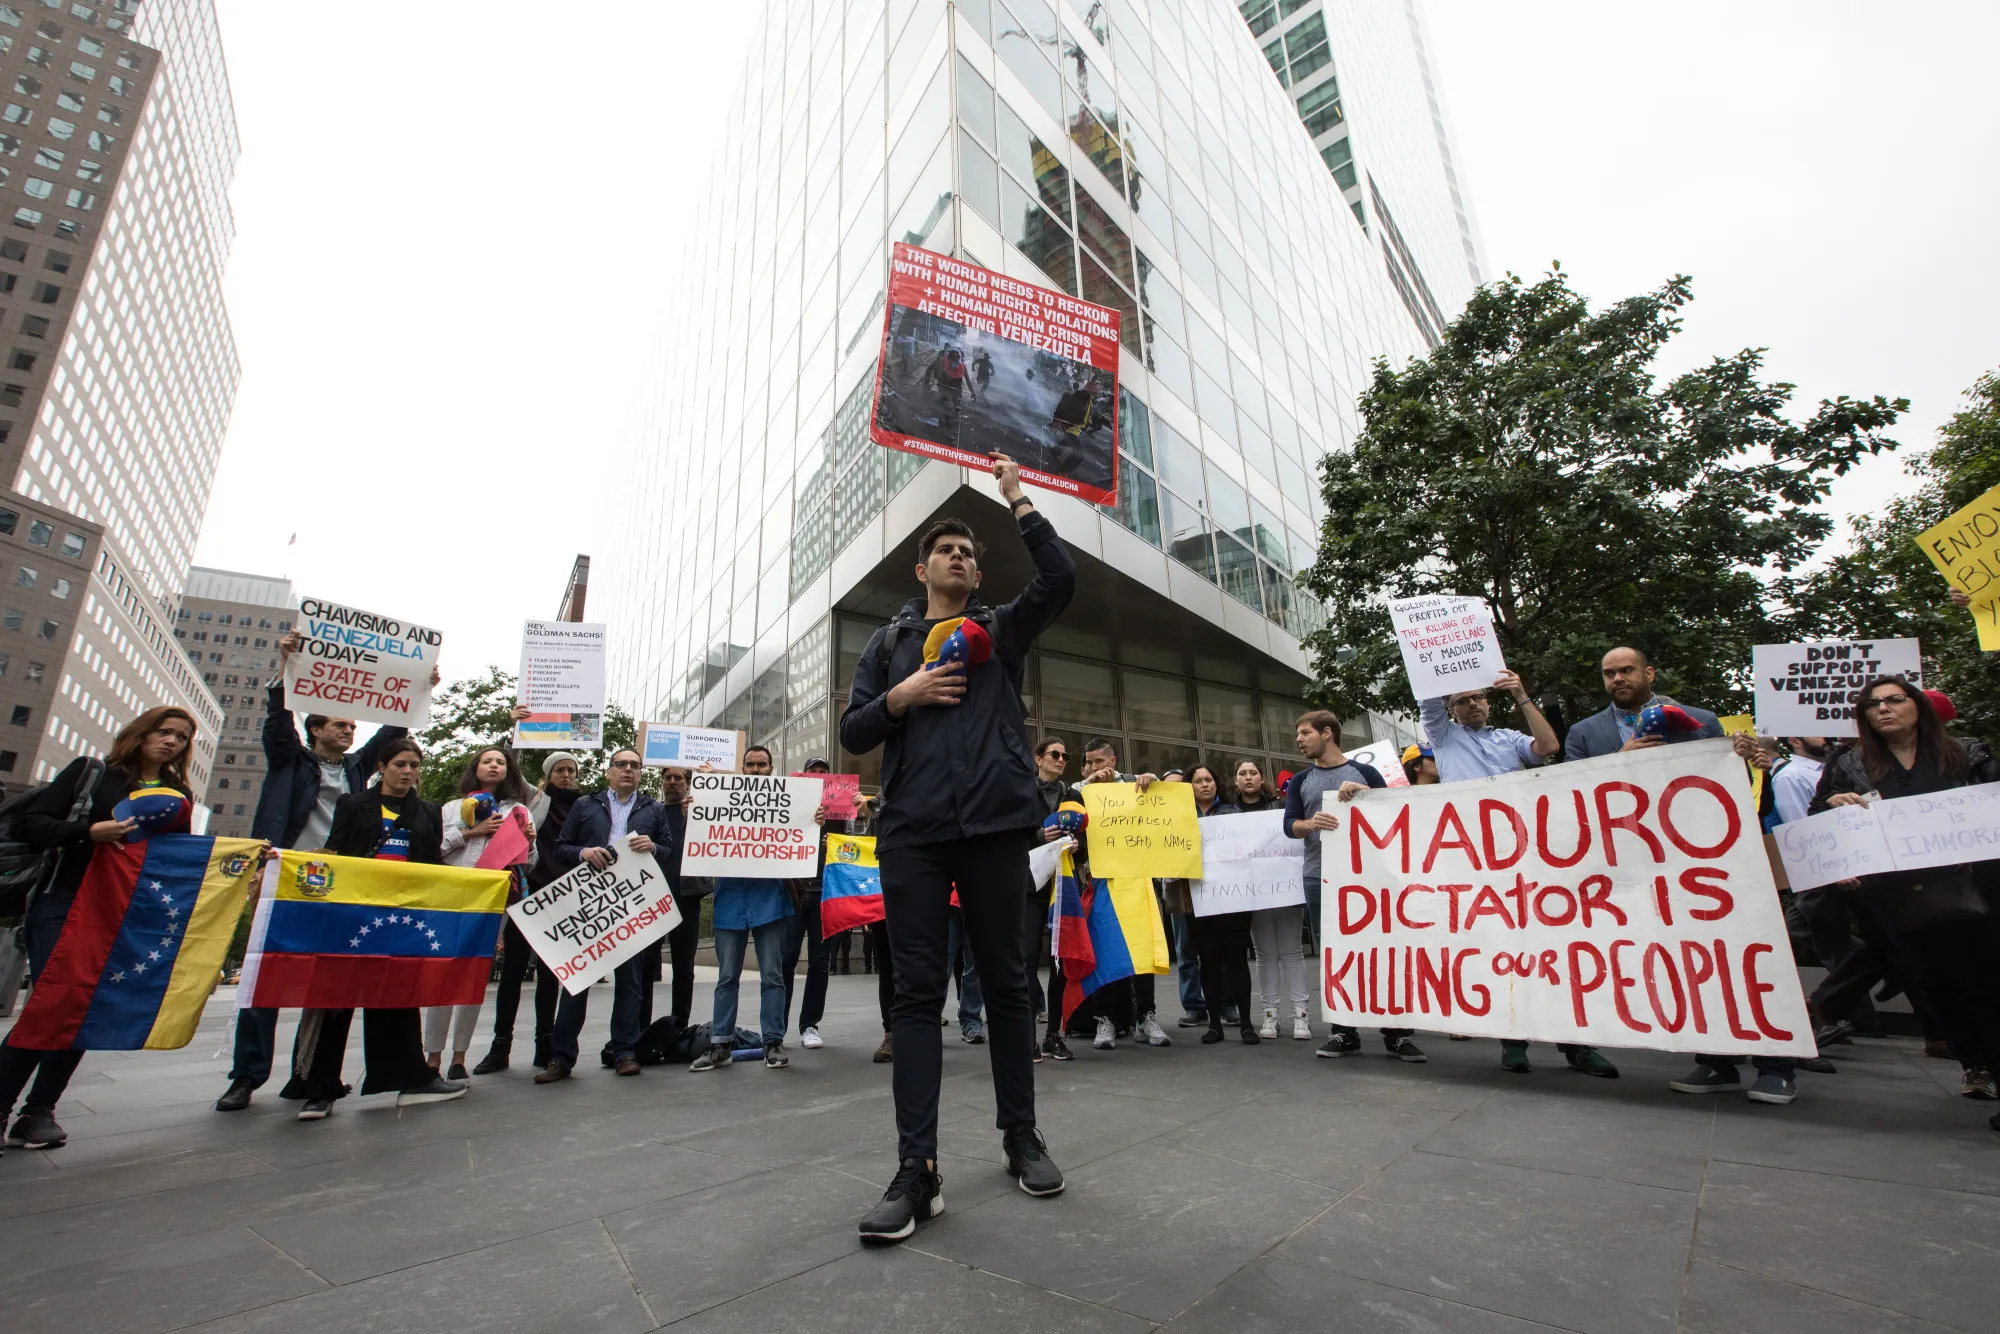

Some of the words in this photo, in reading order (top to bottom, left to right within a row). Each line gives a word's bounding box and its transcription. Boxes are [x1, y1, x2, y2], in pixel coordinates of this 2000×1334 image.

[906, 248, 933, 267] THE
[938, 256, 987, 284] WORLD
[990, 277, 1034, 300] NEEDS
[1036, 290, 1054, 307] TO
[1058, 299, 1109, 324] RECKON
[894, 259, 932, 282] WITH
[935, 272, 988, 299] HUMAN
[991, 290, 1040, 317] RIGHTS
[1043, 307, 1118, 342] VIOLATIONS
[924, 286, 935, 297] +
[940, 289, 1044, 334] HUMANITARIAN
[1048, 325, 1092, 349] CRISIS
[917, 299, 996, 334] AFFECTING
[999, 322, 1092, 366] VENEZUELA
[903, 439, 995, 469] #STANDWITHVENEZUELA
[1932, 506, 2000, 566] ENJO
[1957, 549, 2000, 595] BL
[1394, 599, 1441, 612] GOLDMAN
[1408, 607, 1448, 623] PROFIT$
[1452, 604, 1469, 614] OFF
[301, 600, 400, 637] CHAVISMO
[406, 627, 442, 647] AND
[527, 622, 546, 630] HEY,
[1400, 628, 1420, 639] THE
[1425, 619, 1458, 634] KILLING
[1461, 614, 1477, 625] OF
[298, 637, 378, 664] TODAY=
[309, 619, 423, 661] VENEZUELA
[1411, 626, 1487, 650] VENEZUELANS
[1420, 651, 1433, 663] BY
[1807, 643, 1874, 662] DON'T
[310, 661, 376, 688] STATE
[384, 677, 411, 693] OF
[1434, 657, 1481, 676] REGIME
[1787, 660, 1881, 676] SUPPORT
[293, 678, 410, 713] EXCEPTION
[1798, 690, 1862, 705] HUNG
[1816, 707, 1857, 720] BON
[686, 734, 730, 743] SUPPORTING
[694, 749, 735, 757] VENEZUELA
[692, 776, 786, 793] GOLDMAN
[729, 792, 791, 808] SACHS
[1096, 794, 1125, 818] YOU
[1136, 795, 1166, 807] GIVE
[1888, 805, 1908, 820] A
[692, 806, 790, 824] SUPPORTS
[1349, 775, 1742, 874] MADURO
[1950, 811, 1965, 824] is
[708, 824, 804, 843] MADURO'S
[1106, 836, 1115, 847] A
[1124, 835, 1152, 849] BAD
[1164, 834, 1193, 851] NAME
[1784, 825, 1837, 863] Giving
[687, 842, 817, 860] DICTATORSHIP
[1808, 851, 1849, 879] Money
[578, 871, 616, 905] AND
[1652, 866, 1735, 927] IS
[544, 868, 654, 943] VENEZUELA
[568, 900, 631, 947] TODAY
[554, 893, 673, 982] DICTATORSHIP
[1324, 946, 1492, 1018] KILLING
[1491, 949, 1561, 987] OUR
[1567, 938, 1794, 1043] PEOPLE
